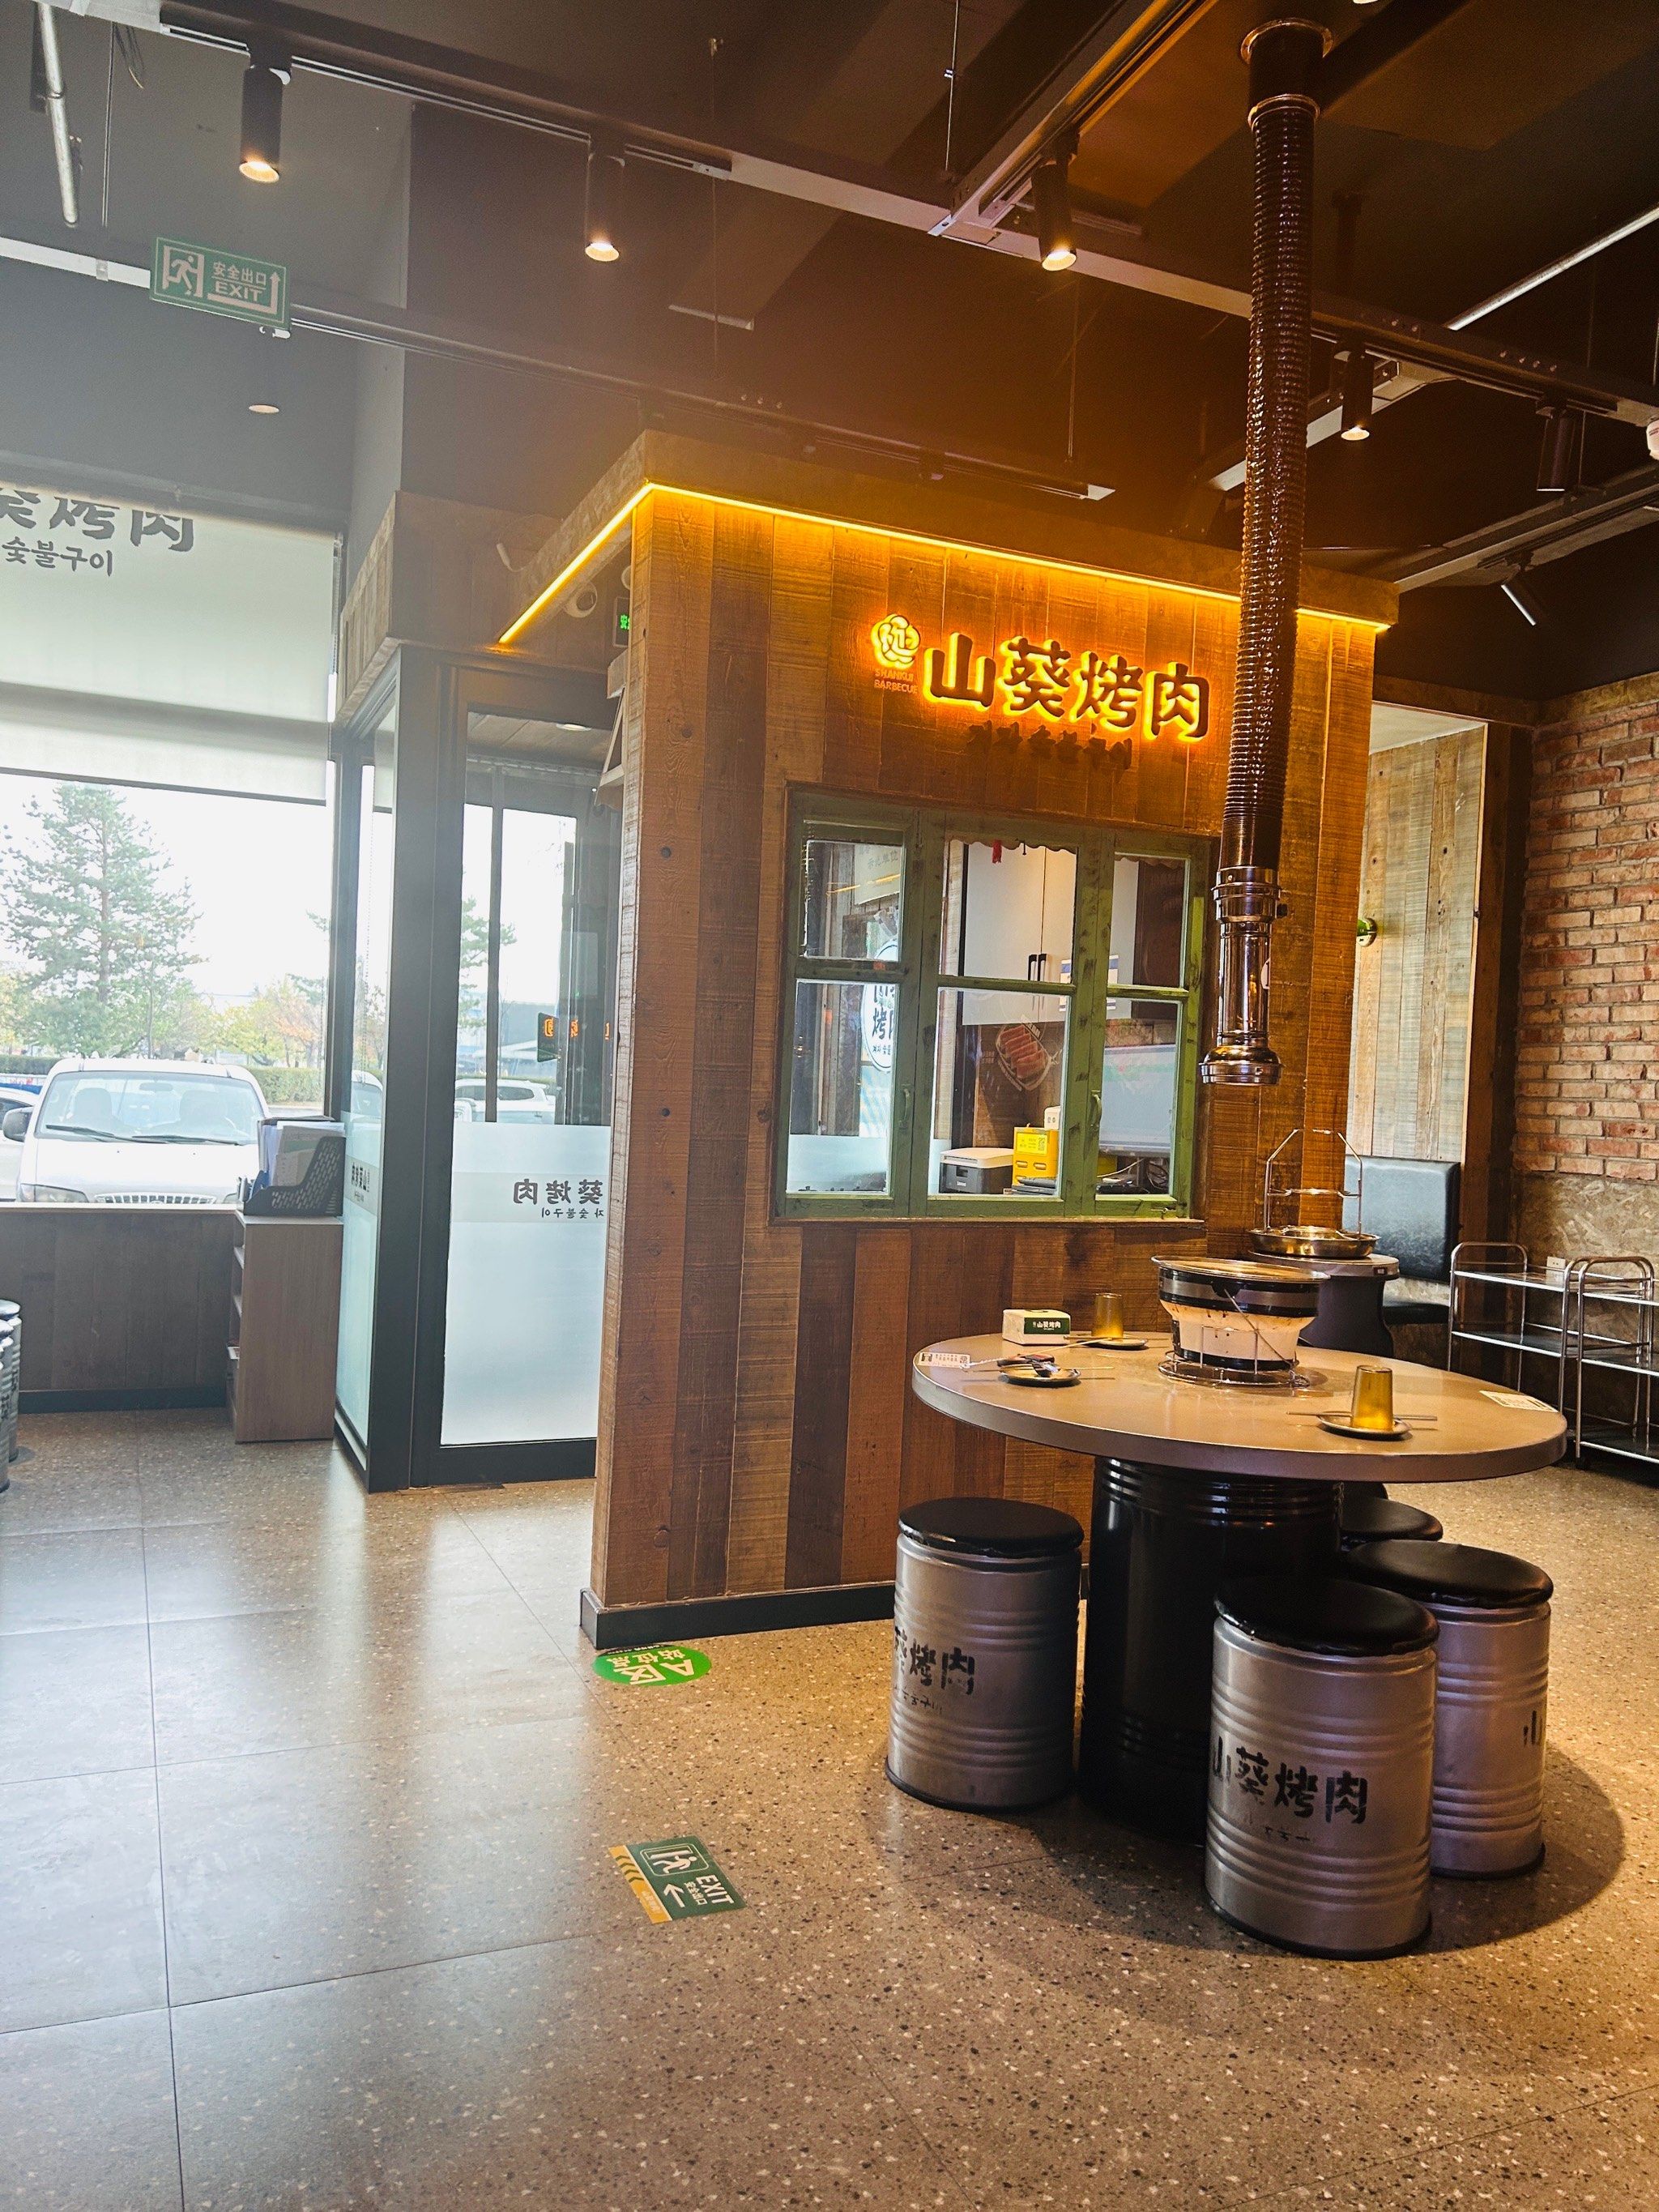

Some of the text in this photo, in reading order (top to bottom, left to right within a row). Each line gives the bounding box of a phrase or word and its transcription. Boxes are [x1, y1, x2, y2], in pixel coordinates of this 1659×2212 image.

[212, 261, 267, 286] 安全出口
[215, 280, 263, 302] EXIT
[1, 536, 114, 578] 숯불구이
[873, 679, 919, 694] BARBECUE
[923, 630, 1210, 743] 山葵烤肉
[606, 1649, 685, 1668] 站位点
[1212, 1735, 1369, 1825] 山葵烤肉
[684, 1881, 709, 1906] 安全出口
[695, 1874, 735, 1905] EXIT
